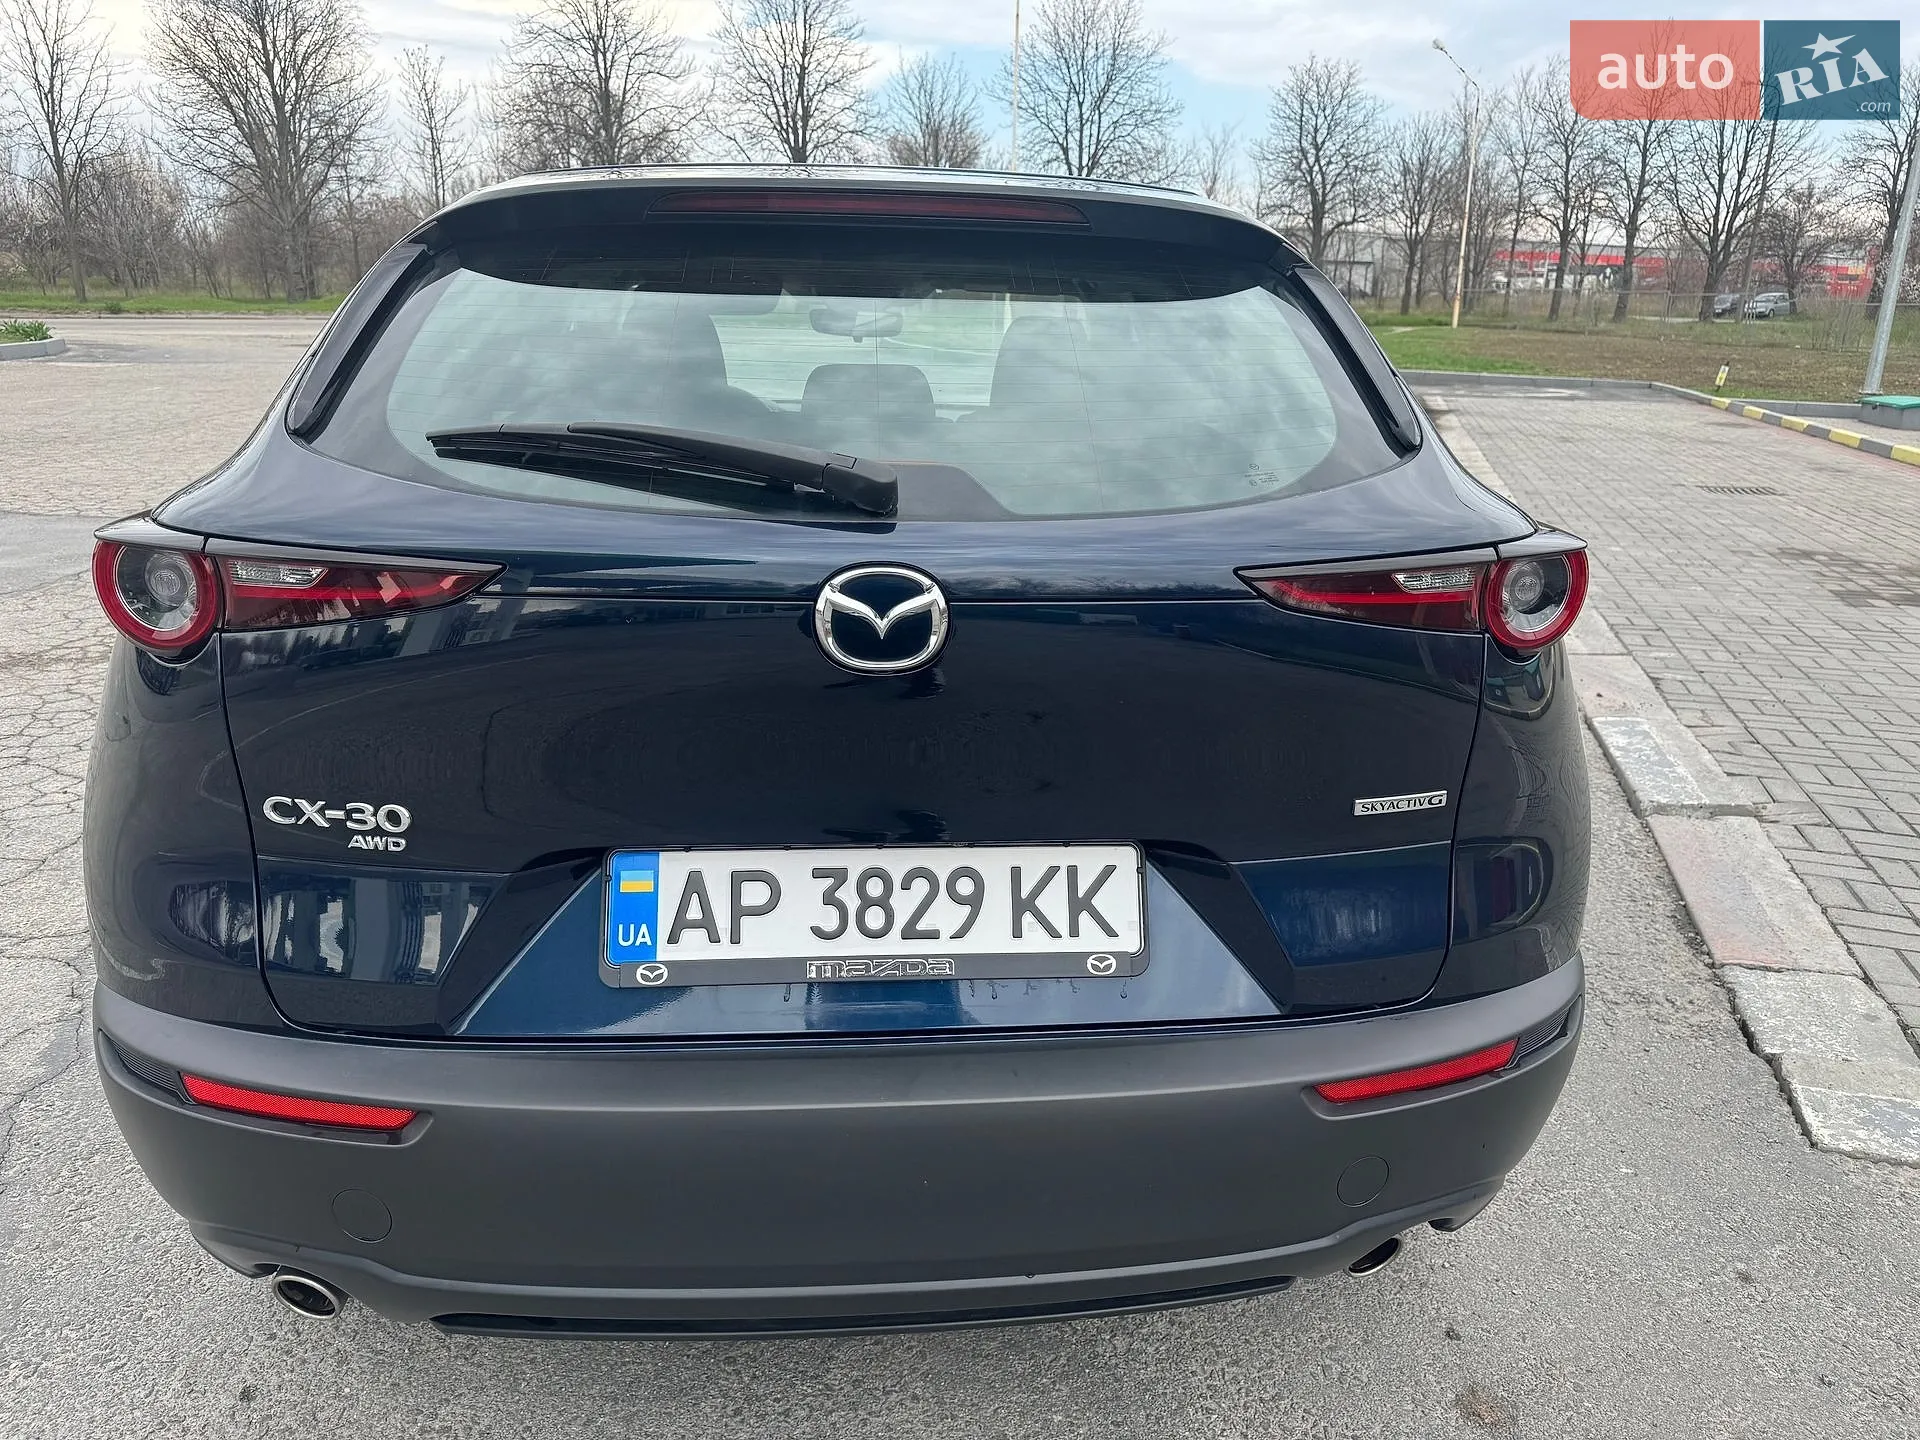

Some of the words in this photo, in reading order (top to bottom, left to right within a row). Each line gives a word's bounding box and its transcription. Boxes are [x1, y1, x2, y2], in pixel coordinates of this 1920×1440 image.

[263, 796, 412, 833] CX-30
[348, 834, 406, 852] AWD
[666, 870, 782, 945] AP
[810, 866, 986, 940] 3829
[1011, 864, 1119, 939] KK
[618, 923, 653, 947] UA
